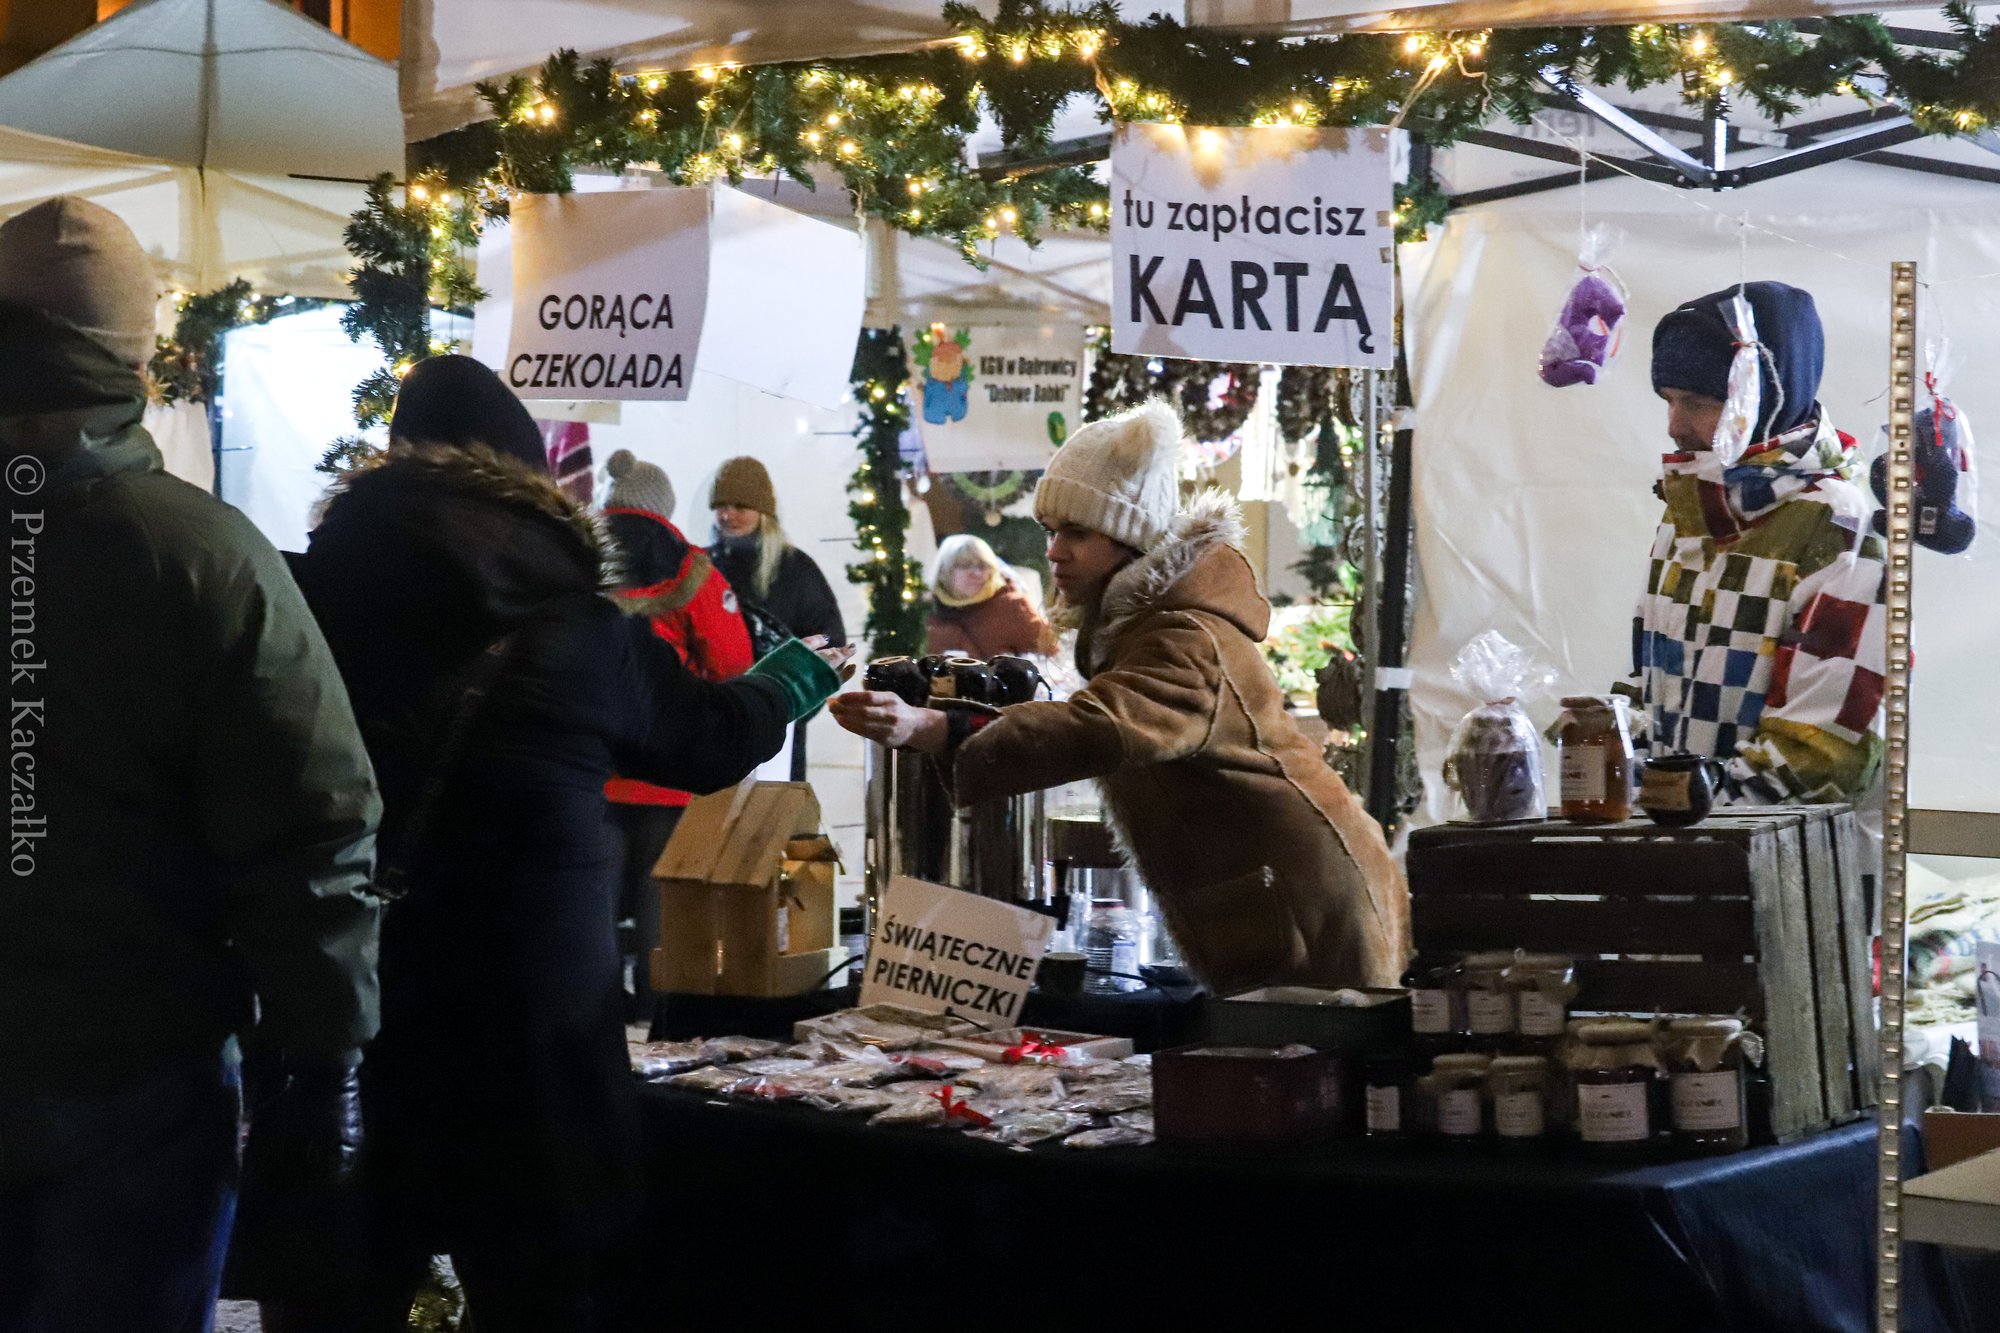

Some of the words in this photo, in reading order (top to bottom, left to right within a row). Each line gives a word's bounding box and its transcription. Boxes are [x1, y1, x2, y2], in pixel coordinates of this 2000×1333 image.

[1123, 189, 1154, 229] tu
[1167, 195, 1366, 242] zapłacisz
[538, 293, 674, 338] GORĄCA
[1129, 254, 1375, 354] KARTĄ
[509, 353, 683, 388] CZEKOLADA
[881, 914, 1035, 980] ŚWIĄTECZNE
[872, 958, 1018, 1018] PIERNICZKI
